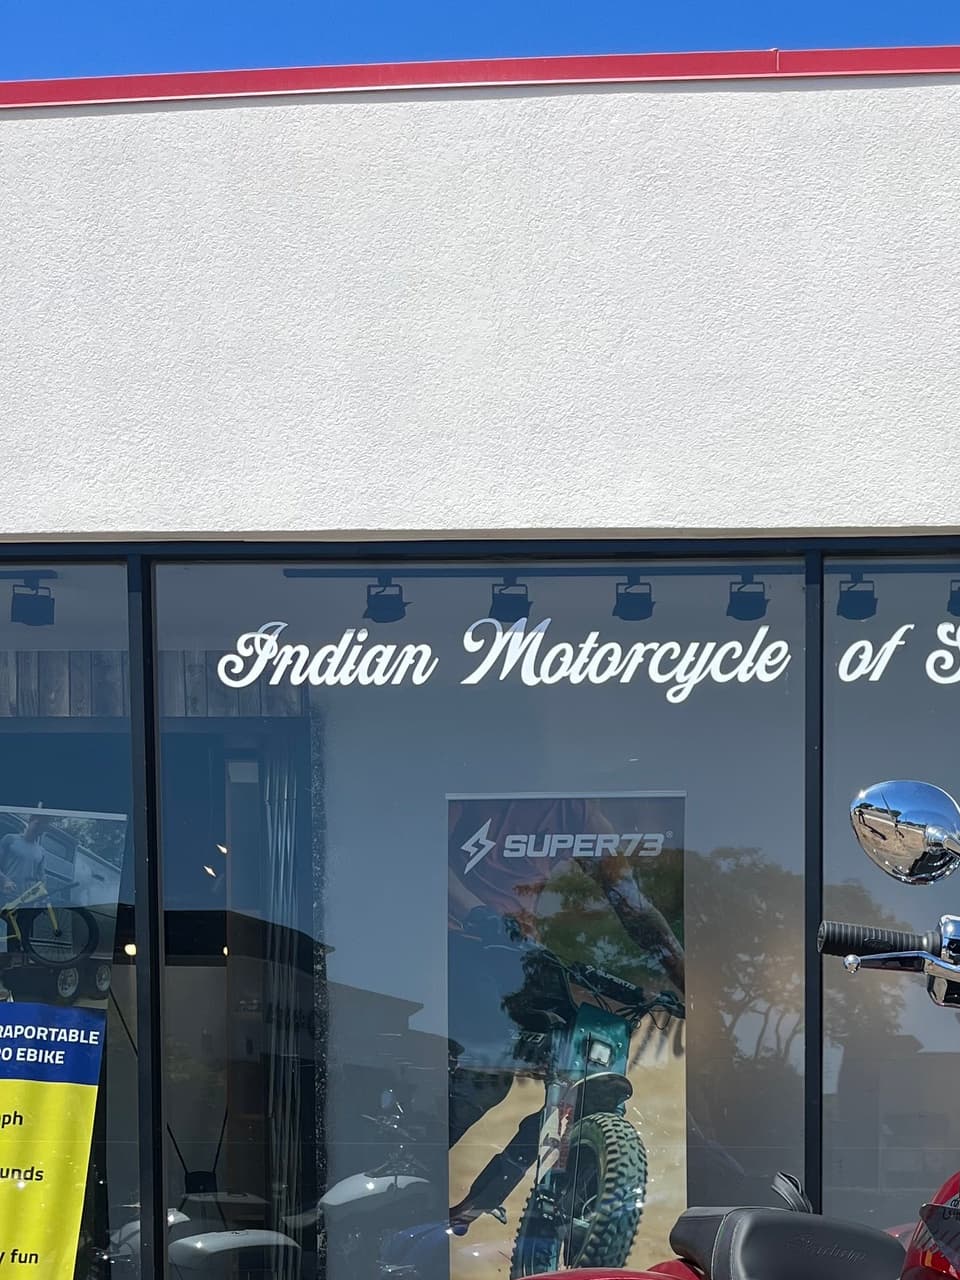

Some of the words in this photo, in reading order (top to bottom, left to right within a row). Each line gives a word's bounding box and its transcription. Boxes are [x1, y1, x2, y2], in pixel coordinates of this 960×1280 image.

[217, 621, 439, 688] Indian
[460, 617, 792, 703] Motorcycle
[838, 623, 915, 682] of
[16, 1047, 66, 1065] EBIKE
[10, 1249, 39, 1264] fun
